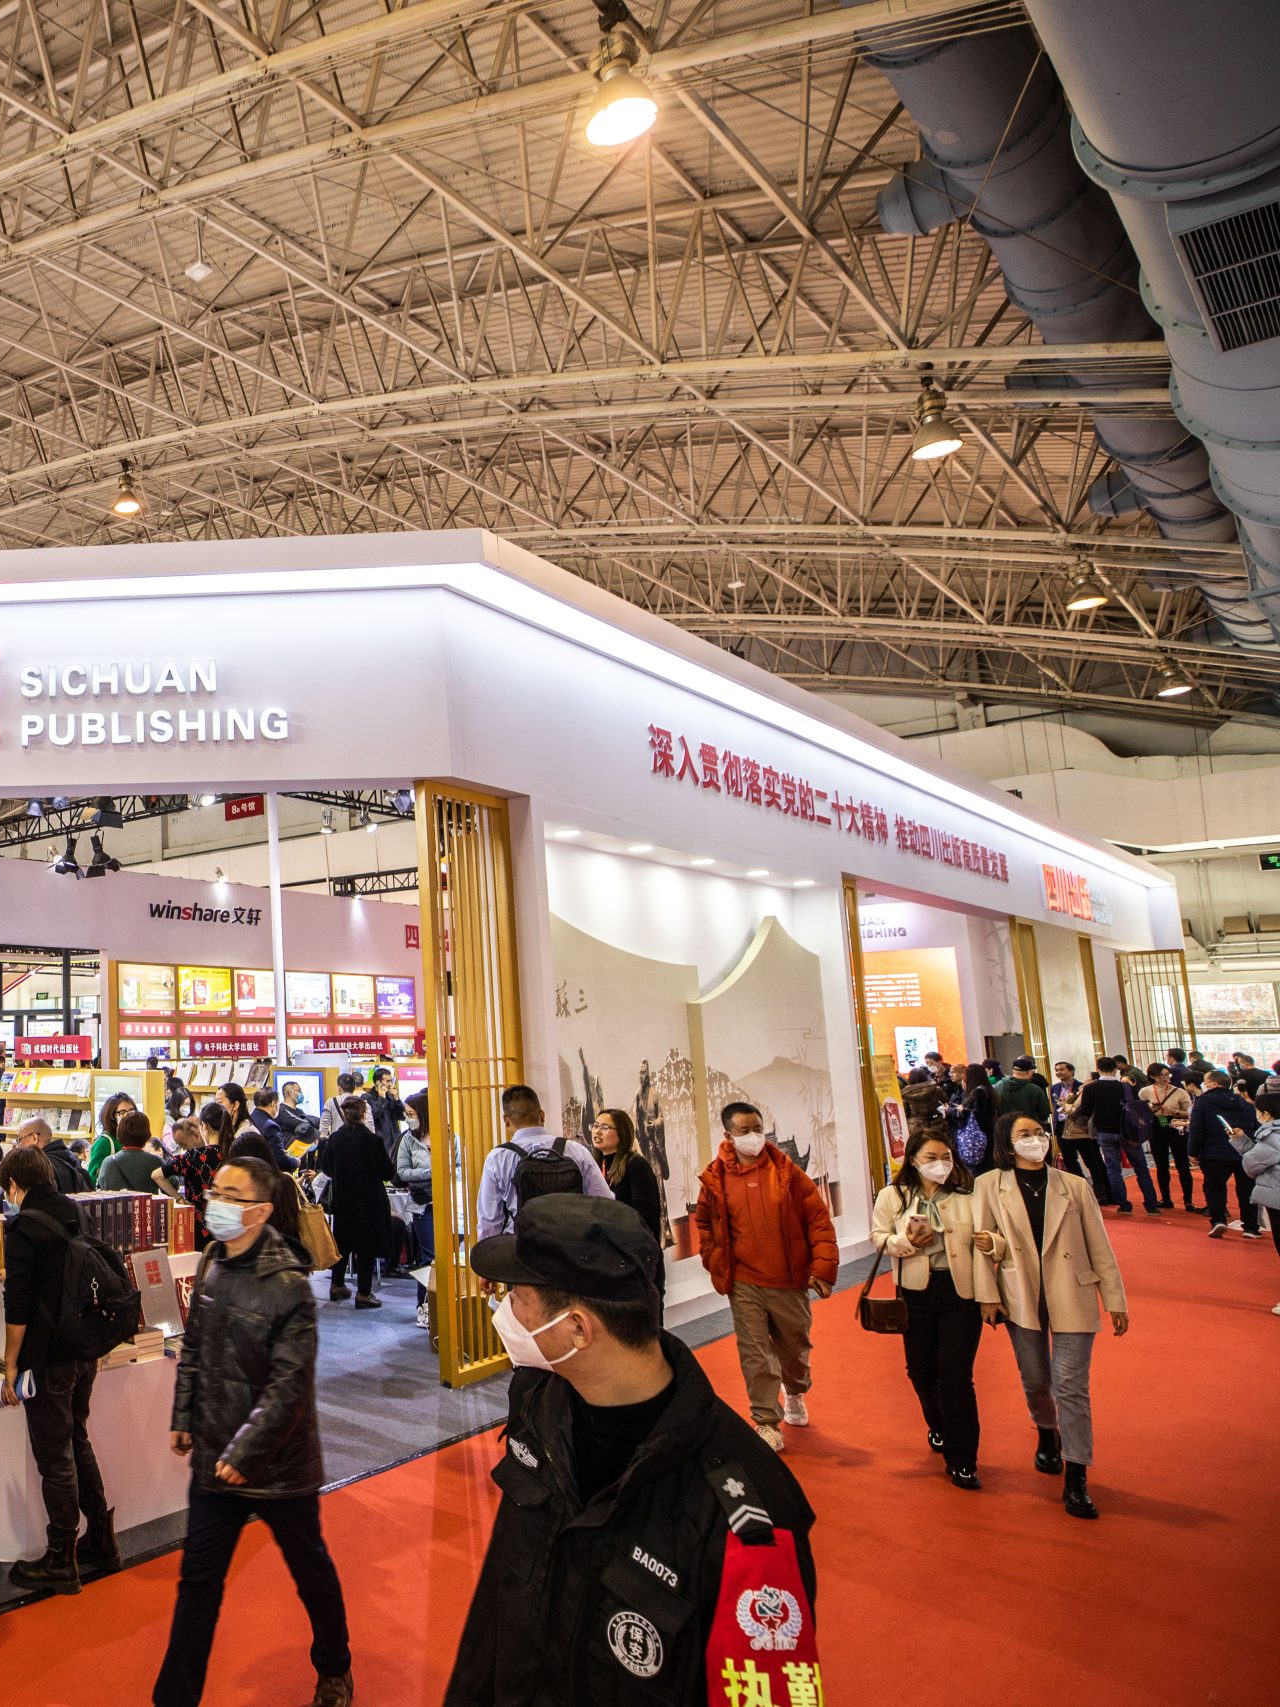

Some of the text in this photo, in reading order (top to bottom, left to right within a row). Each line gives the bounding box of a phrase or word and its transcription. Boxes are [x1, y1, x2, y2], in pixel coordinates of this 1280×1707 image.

[20, 660, 218, 700] SICHUAN
[20, 706, 290, 748] PUBLISHING
[647, 722, 1010, 884] 深入贯彻落实党的二十大精神 推动四川出版高质量发展
[149, 900, 262, 927] winshare 文轩
[33, 1044, 80, 1054] 成都时代出版社
[204, 1042, 260, 1052] 电子科技大学出版社
[328, 1041, 384, 1050] 西南财经大学出版社
[632, 1545, 679, 1588] BA0073
[629, 1625, 644, 1660] 保安
[721, 1657, 825, 1707] 执勤
